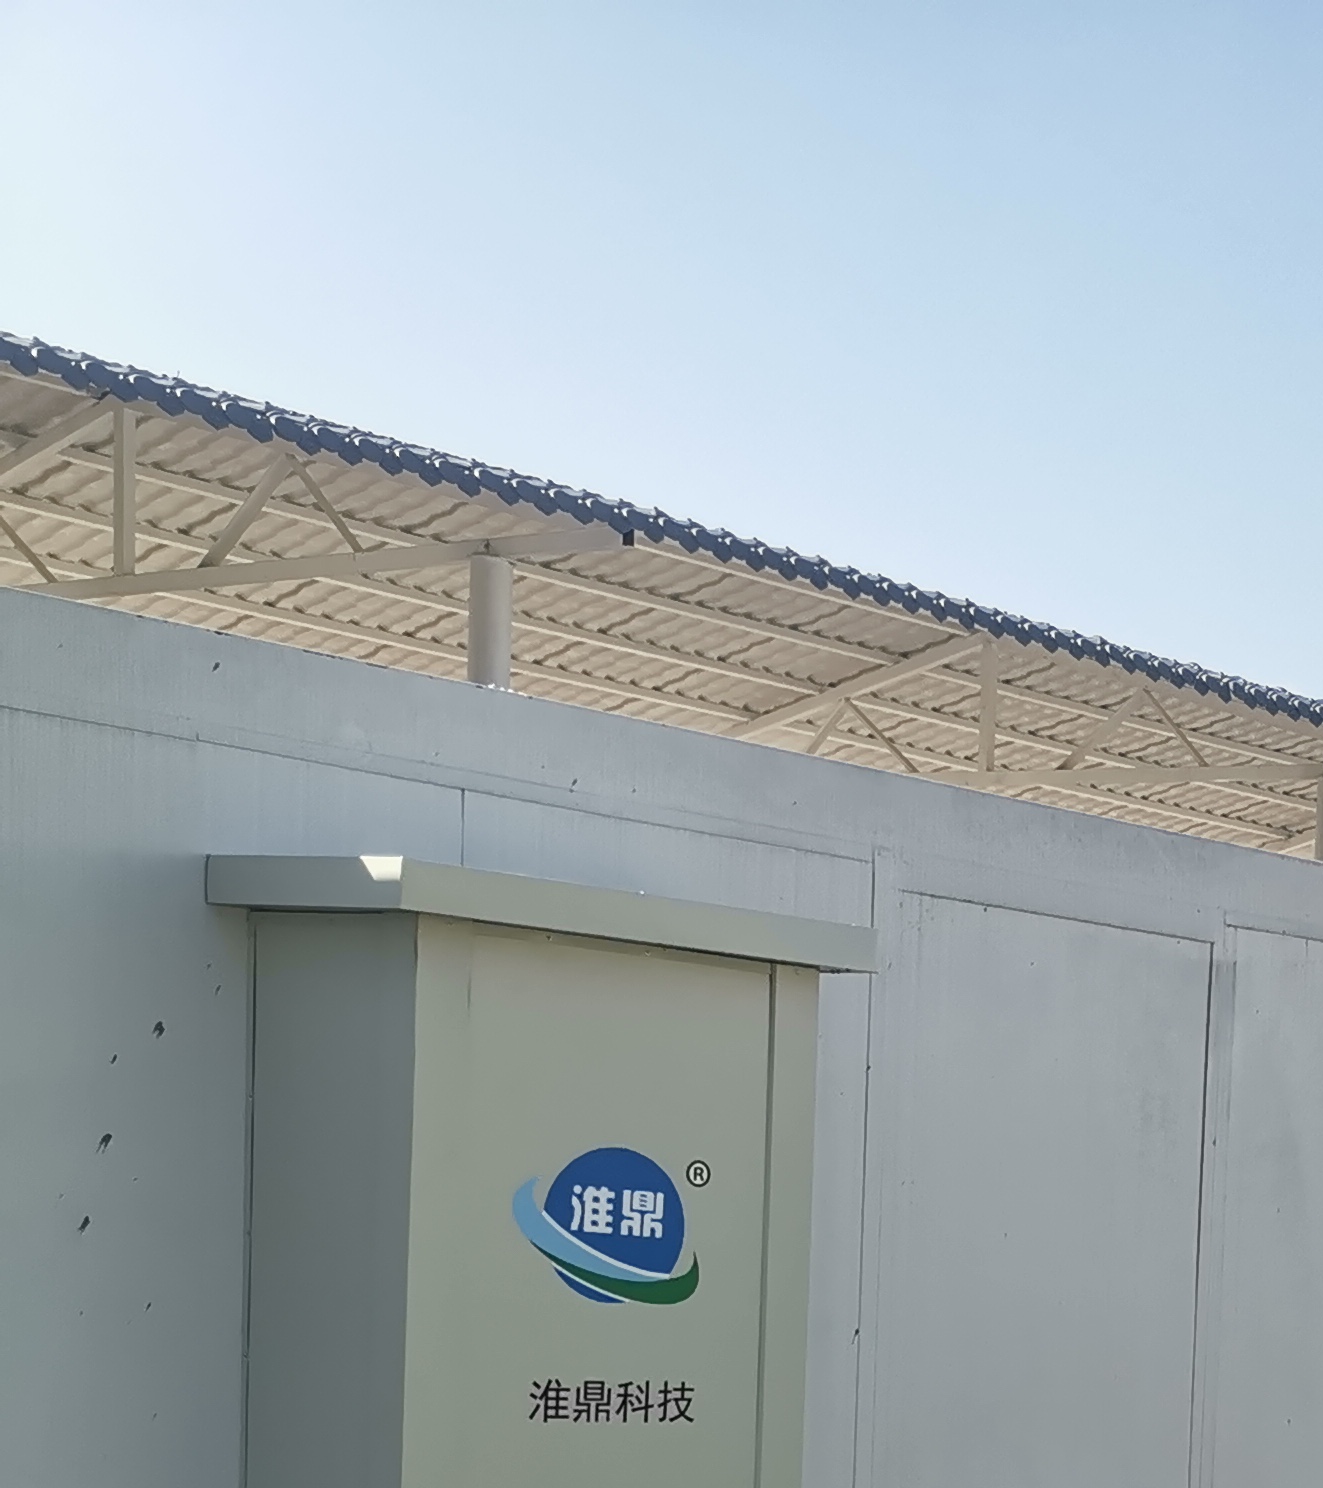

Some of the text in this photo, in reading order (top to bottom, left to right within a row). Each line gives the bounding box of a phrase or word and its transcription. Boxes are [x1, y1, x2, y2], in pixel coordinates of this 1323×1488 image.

[570, 1184, 665, 1239] 淮鼎
[528, 1377, 695, 1424] 淮鼎科技
